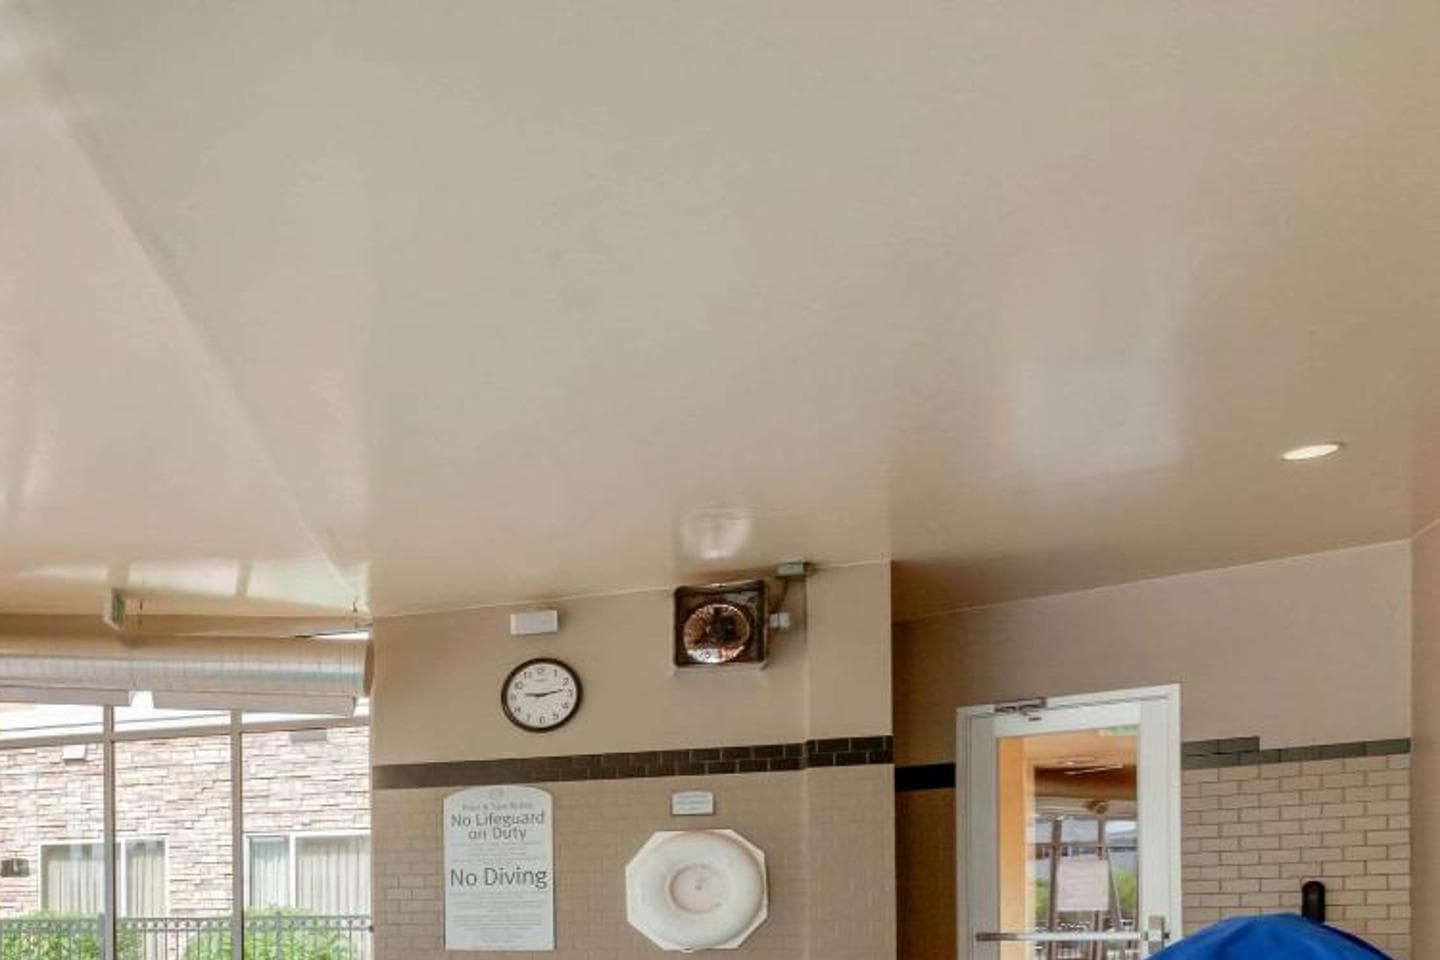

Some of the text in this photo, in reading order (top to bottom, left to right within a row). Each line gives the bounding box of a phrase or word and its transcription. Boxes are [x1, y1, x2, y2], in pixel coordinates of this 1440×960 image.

[451, 810, 545, 828] No Lifeguard
[468, 827, 527, 841] on Duty
[450, 866, 548, 889] No Diving
